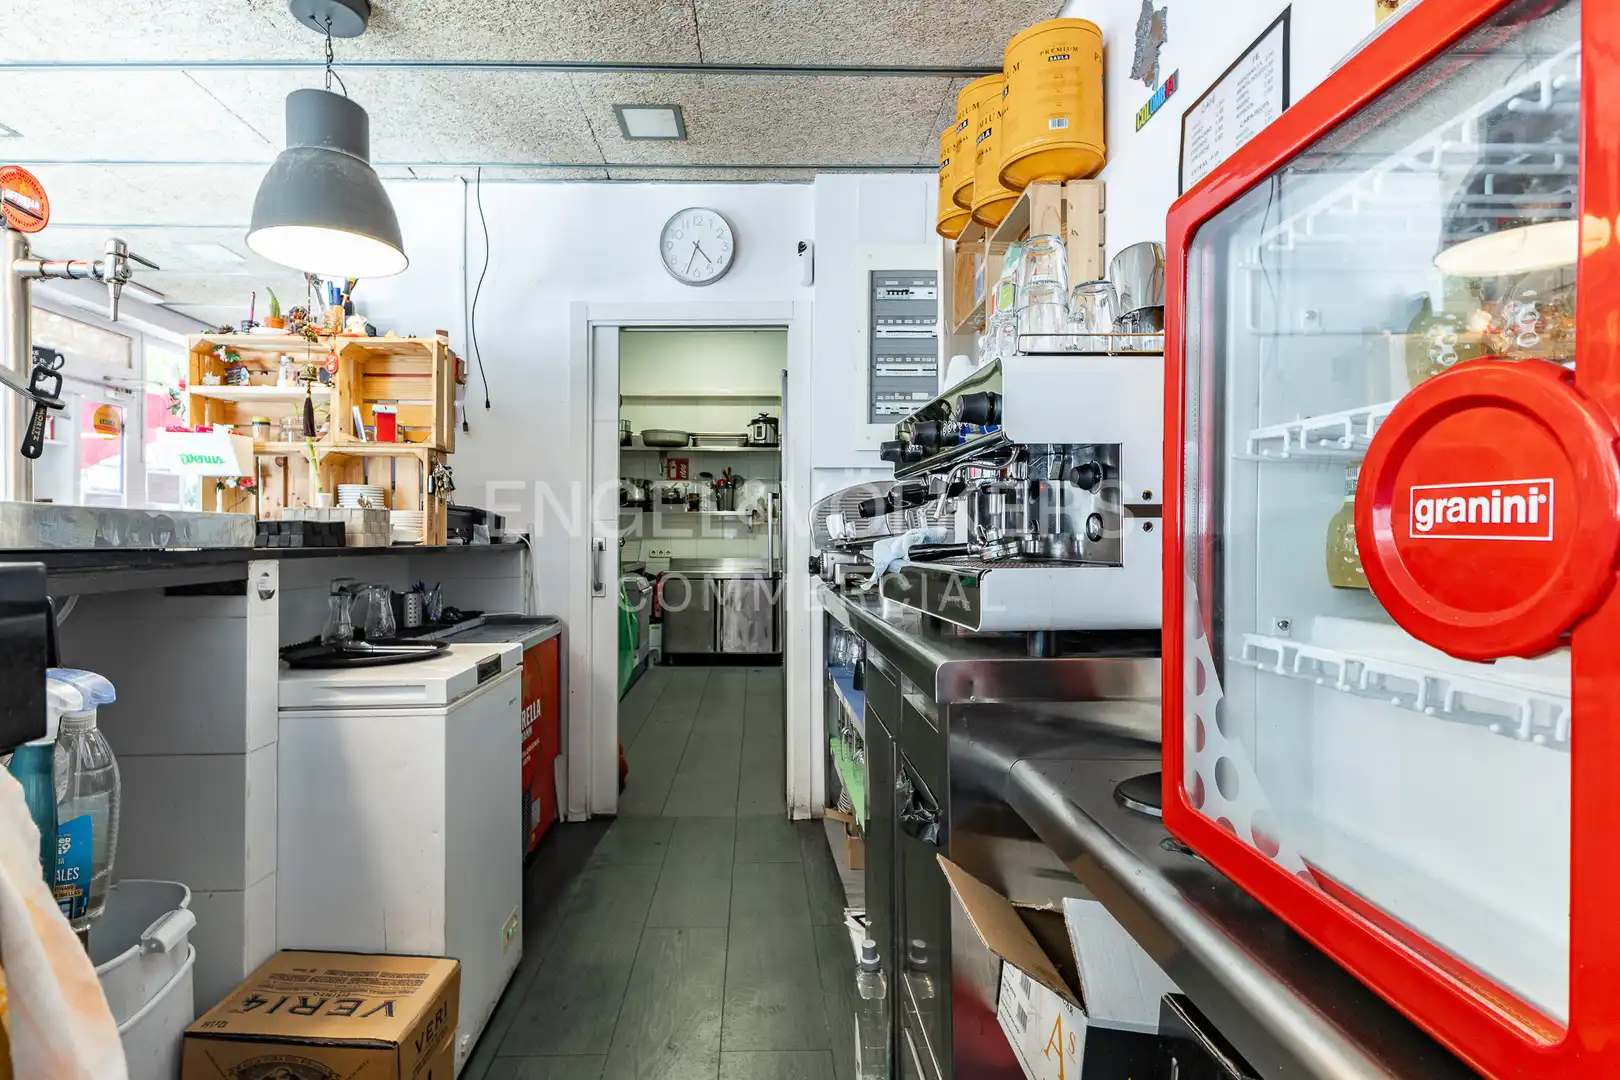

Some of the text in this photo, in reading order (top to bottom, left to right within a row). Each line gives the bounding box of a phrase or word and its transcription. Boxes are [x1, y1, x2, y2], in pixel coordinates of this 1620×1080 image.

[1040, 46, 1079, 56] PREMIUM
[1415, 487, 1539, 532] granini
[521, 698, 541, 731] RELLA
[415, 1000, 447, 1054] VERI
